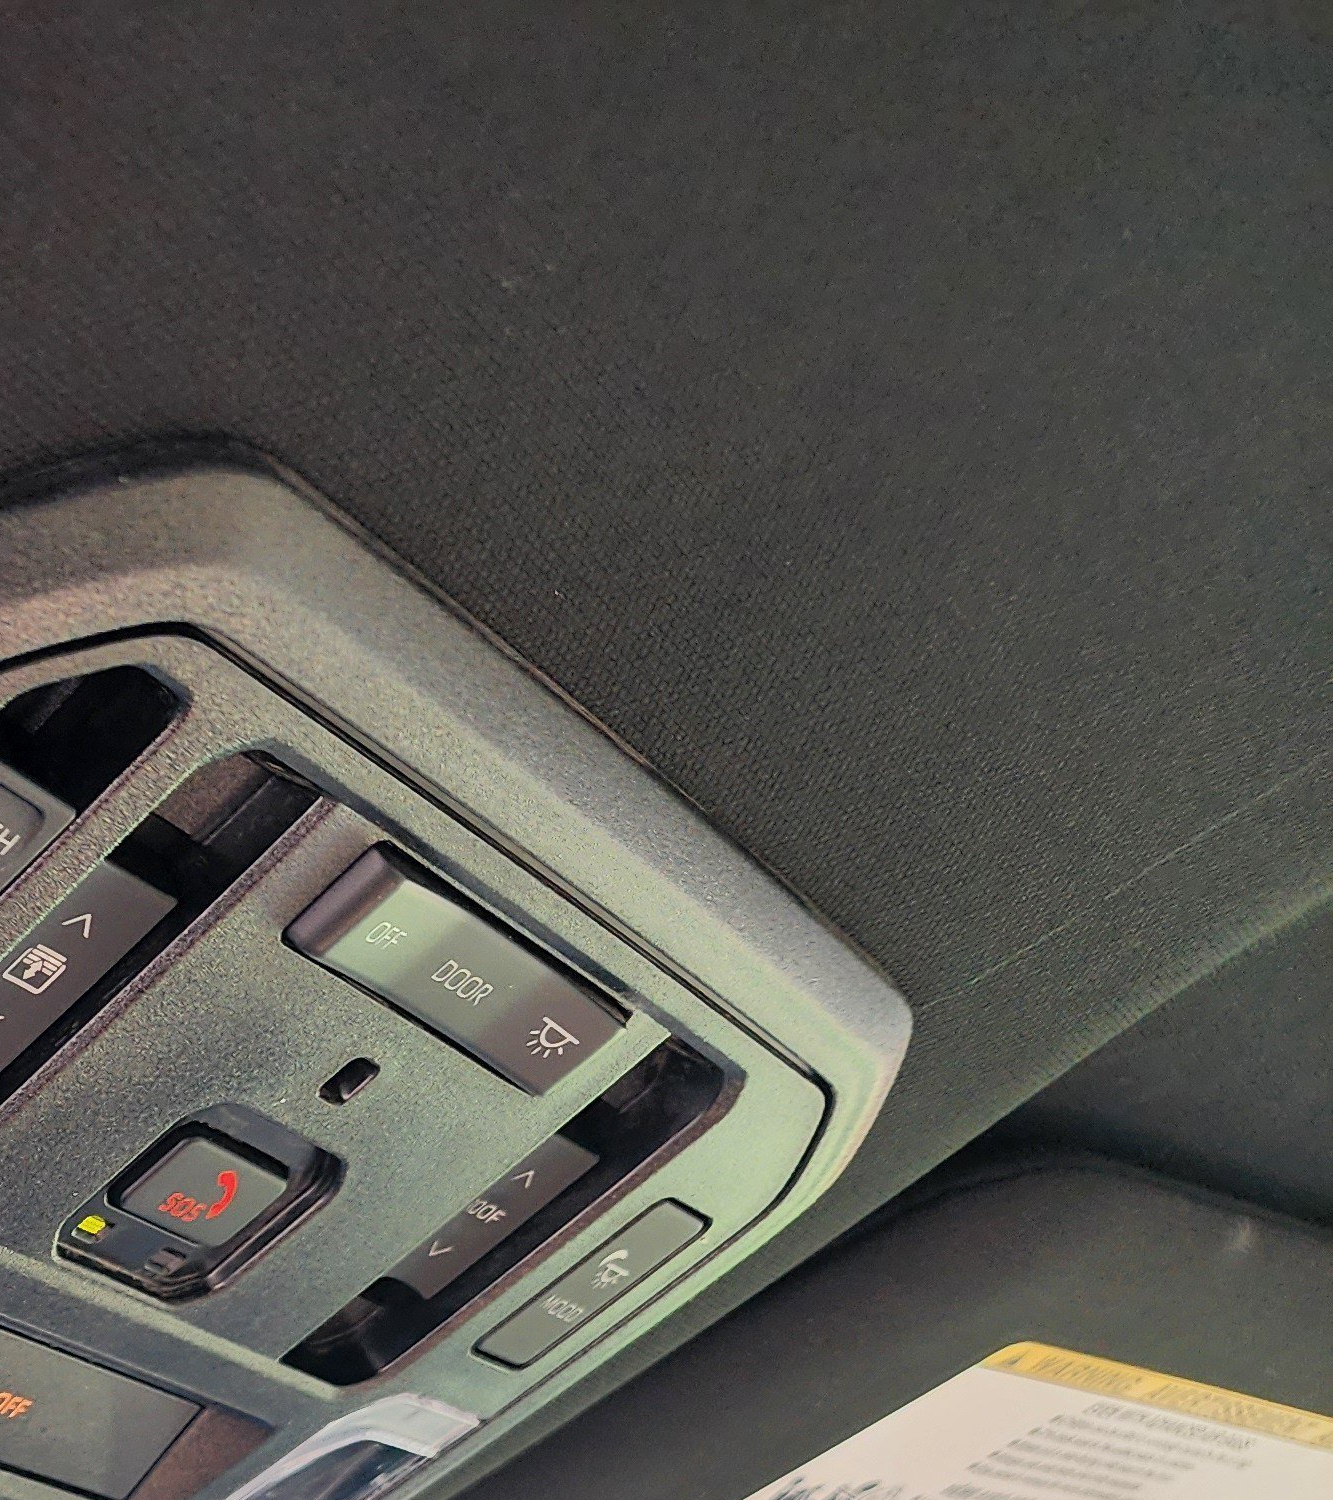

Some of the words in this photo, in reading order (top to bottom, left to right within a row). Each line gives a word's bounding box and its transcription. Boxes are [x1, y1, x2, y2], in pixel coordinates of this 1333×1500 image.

[365, 921, 408, 948] OFF
[431, 959, 495, 1007] DOOR
[157, 1192, 207, 1222] SOS
[541, 1295, 584, 1323] MOOD
